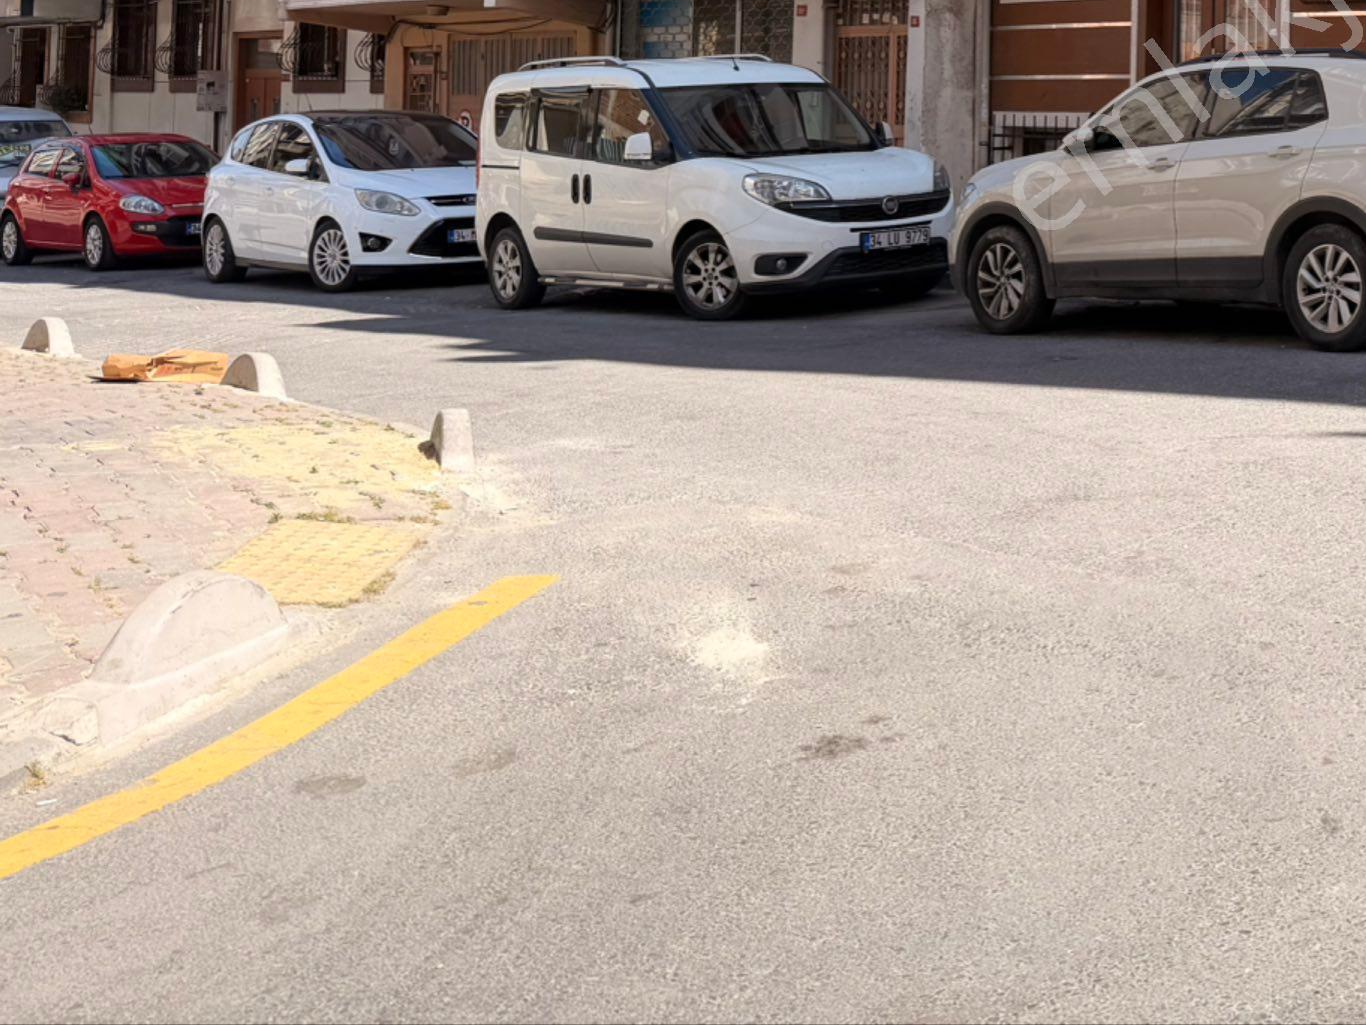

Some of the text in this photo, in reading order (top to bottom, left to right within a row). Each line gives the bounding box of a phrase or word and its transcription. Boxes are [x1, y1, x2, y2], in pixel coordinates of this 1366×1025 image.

[871, 228, 928, 247] 34 LU 9779
